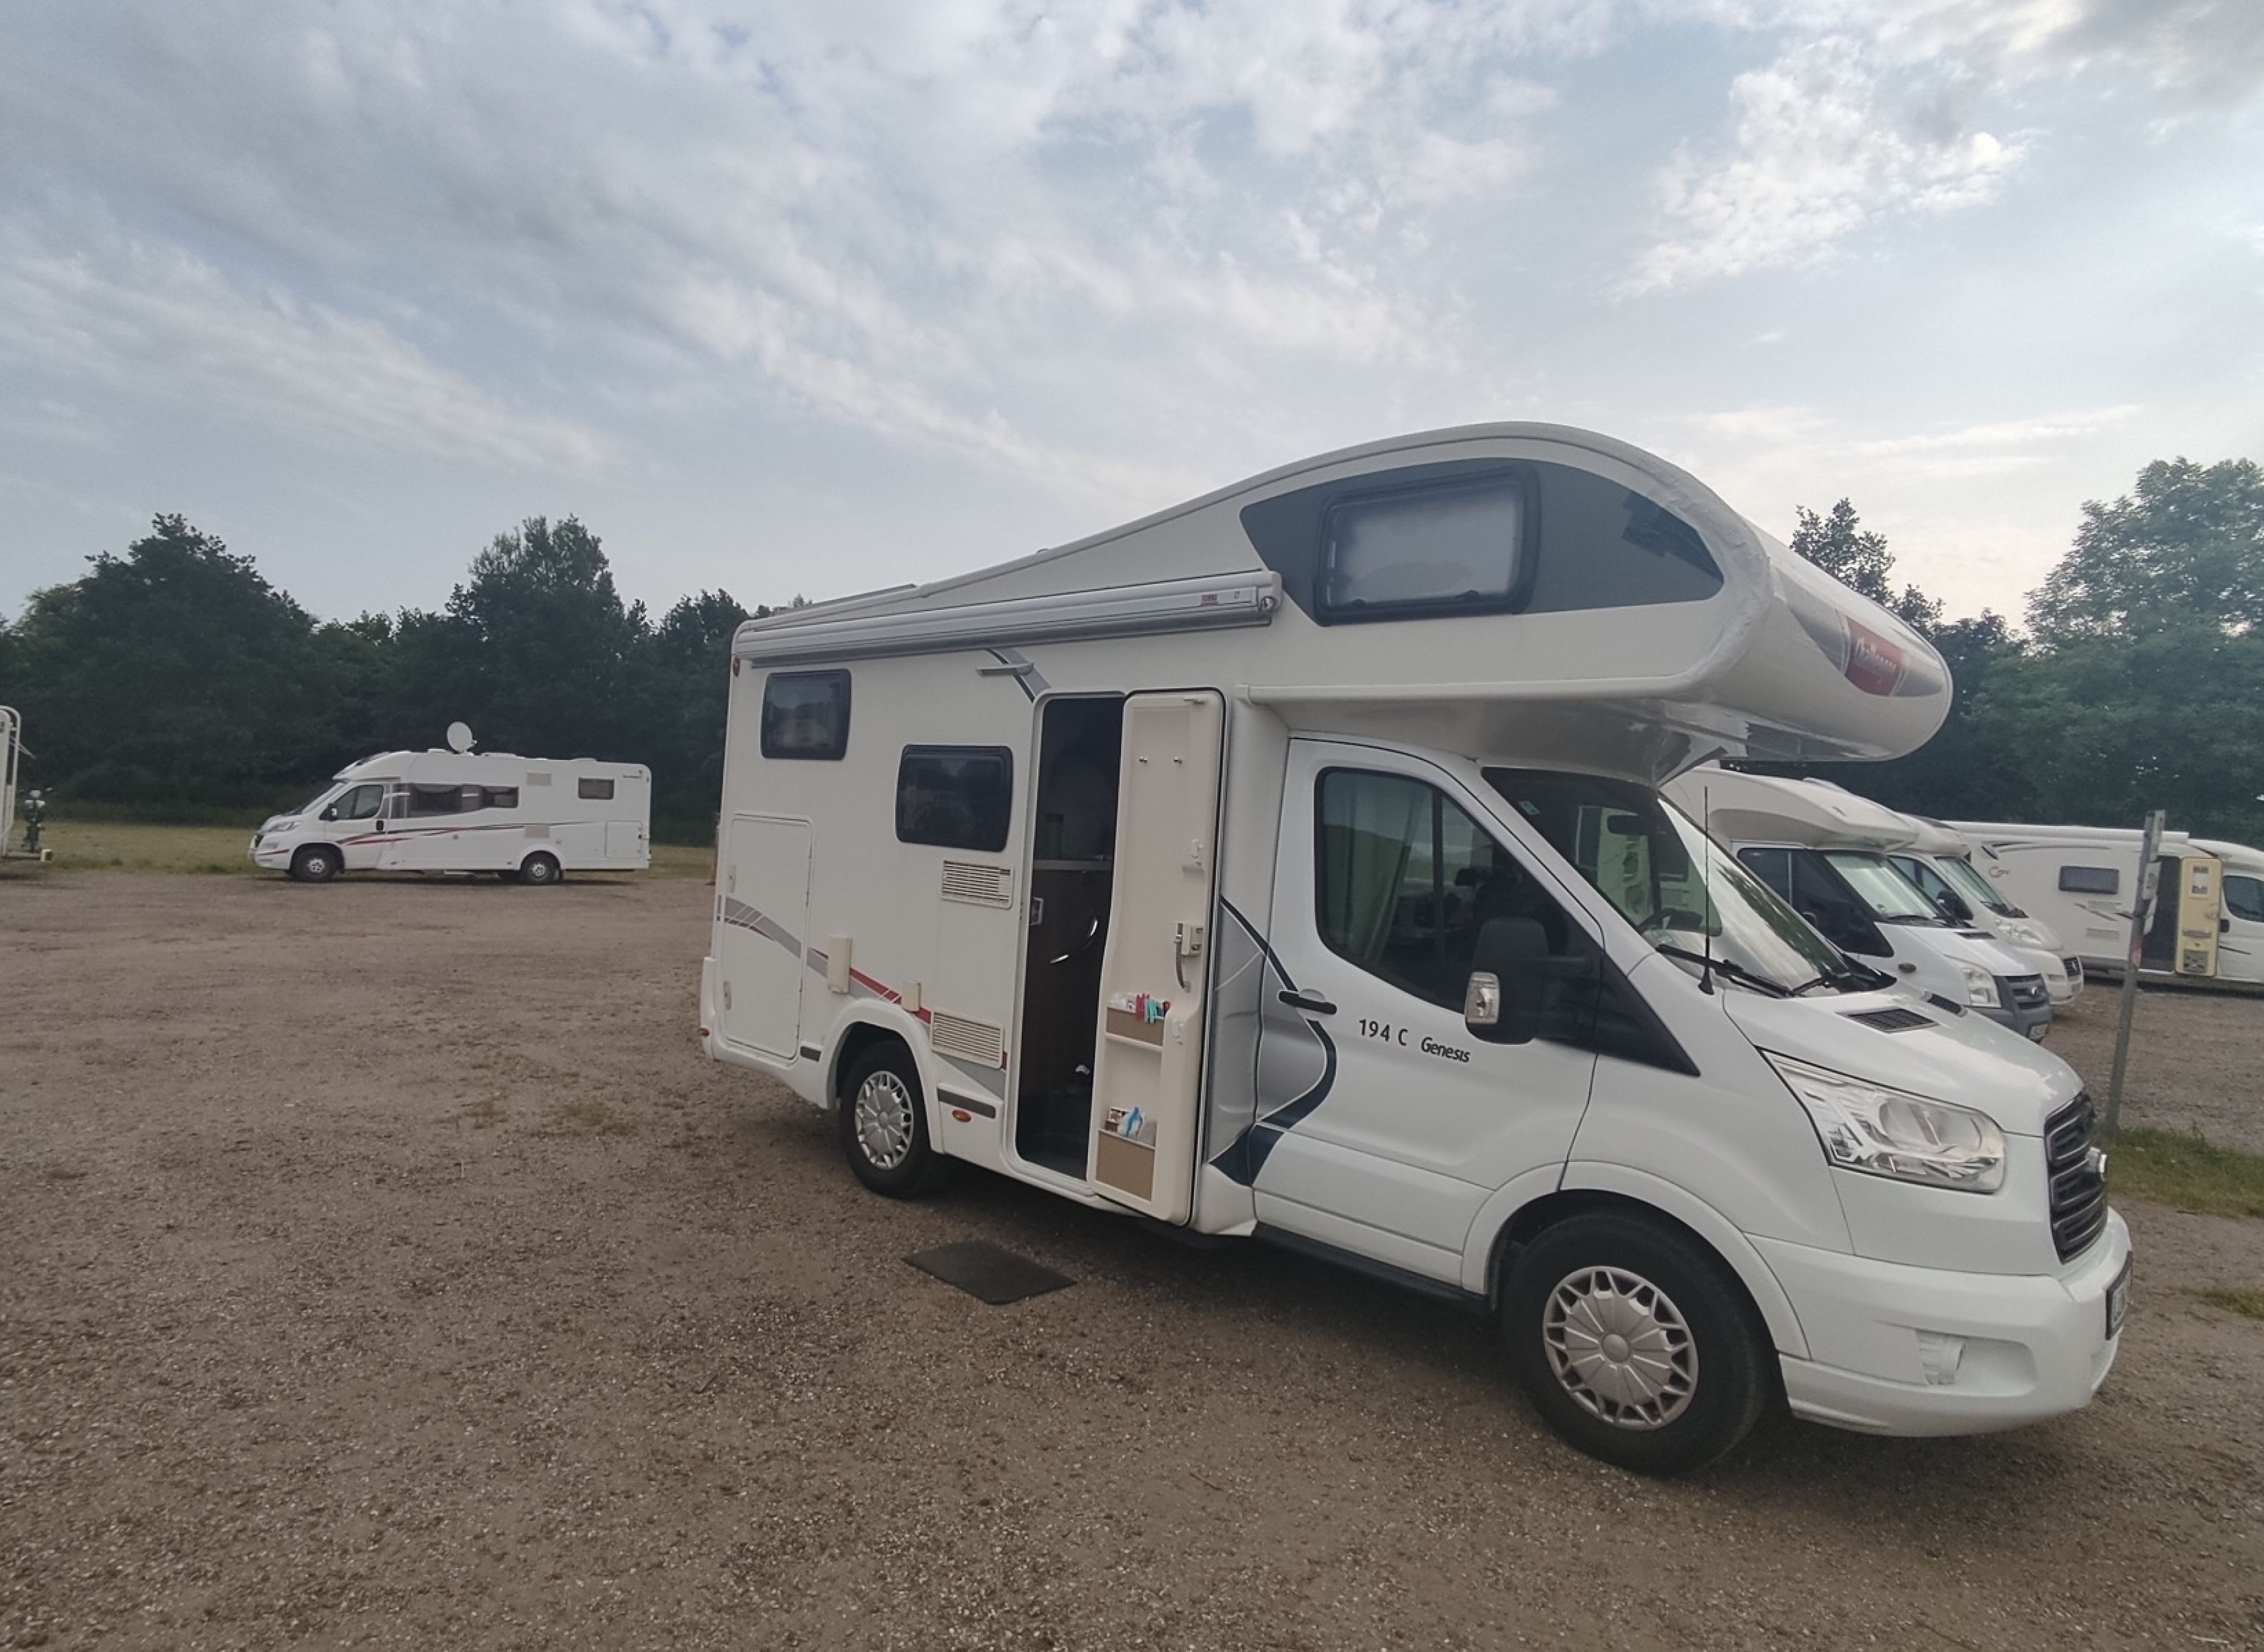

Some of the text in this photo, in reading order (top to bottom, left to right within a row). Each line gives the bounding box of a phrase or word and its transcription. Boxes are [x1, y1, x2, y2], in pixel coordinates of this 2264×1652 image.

[1359, 1019, 1470, 1063] 194 C Genesis
